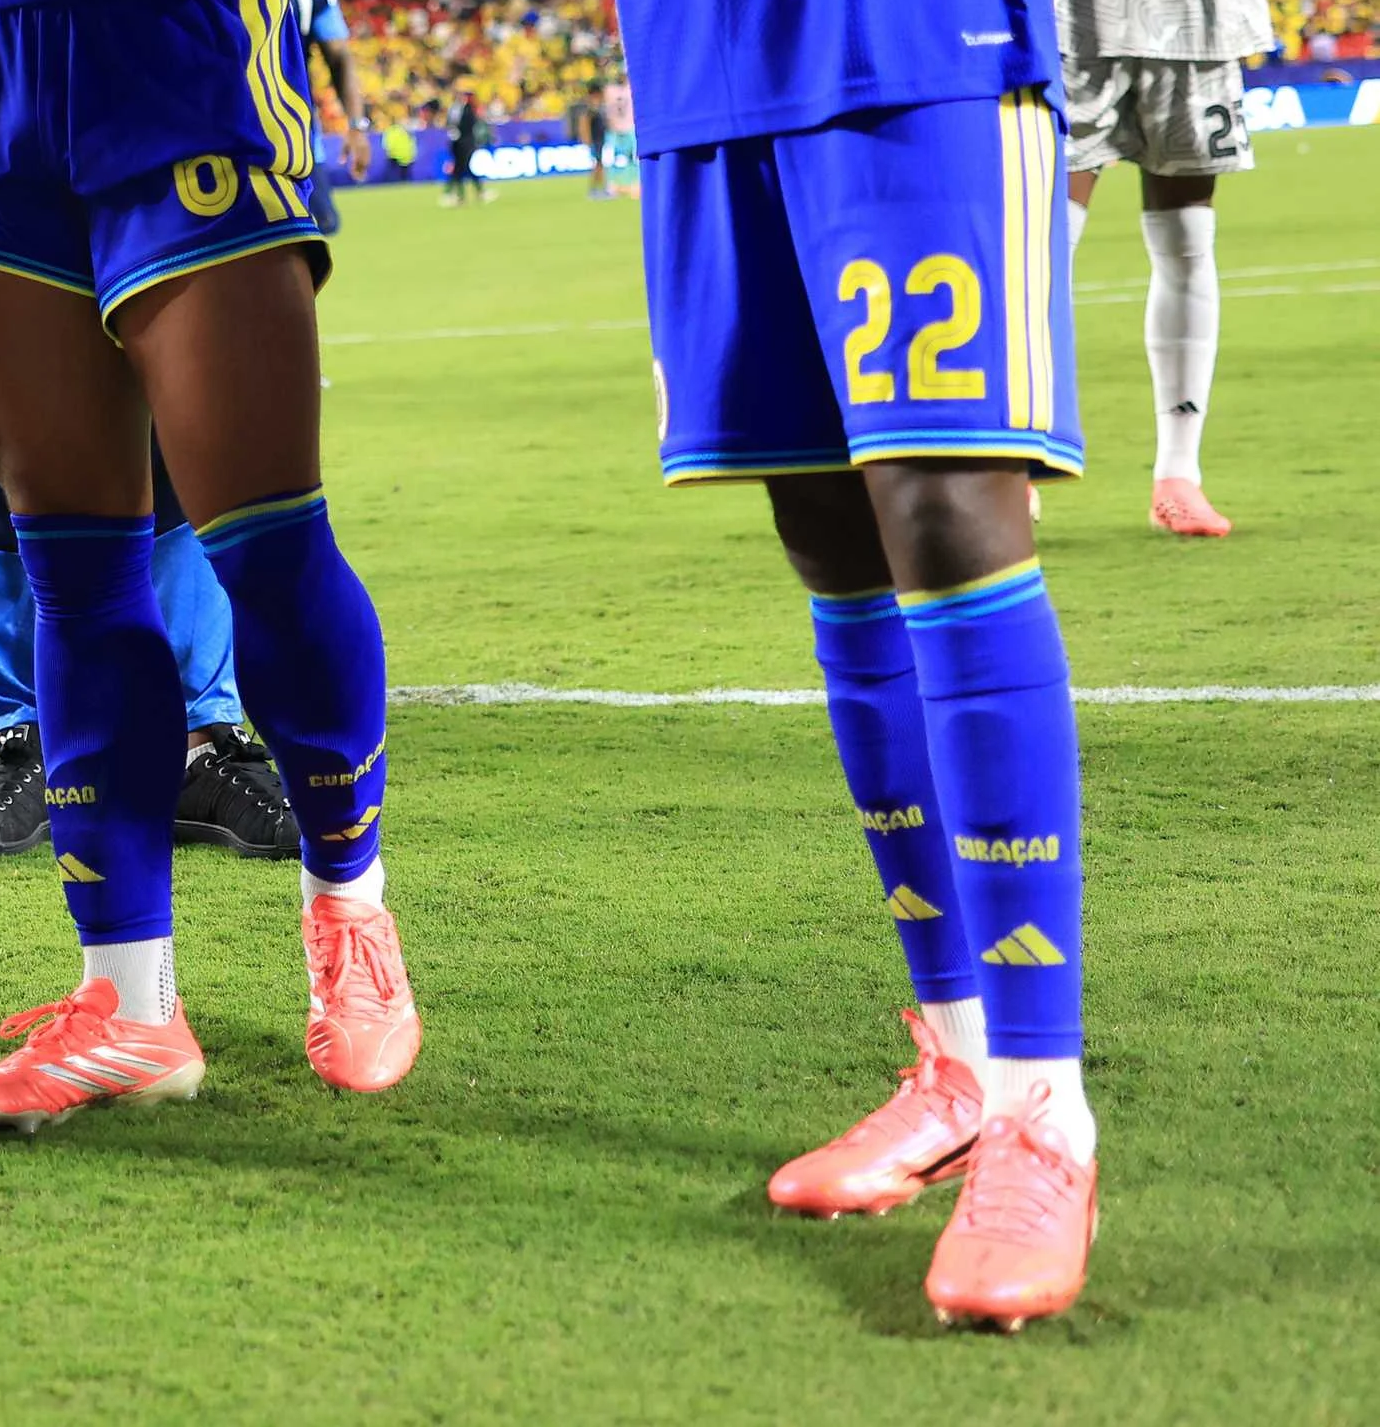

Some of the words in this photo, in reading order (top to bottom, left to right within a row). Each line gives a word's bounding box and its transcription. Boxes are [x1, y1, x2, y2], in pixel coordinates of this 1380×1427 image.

[1242, 85, 1306, 131] SA
[838, 253, 986, 404] 22
[45, 785, 97, 809] AÇAO
[856, 805, 925, 836] RAÇAO
[954, 834, 1060, 869] CURAÇAO
